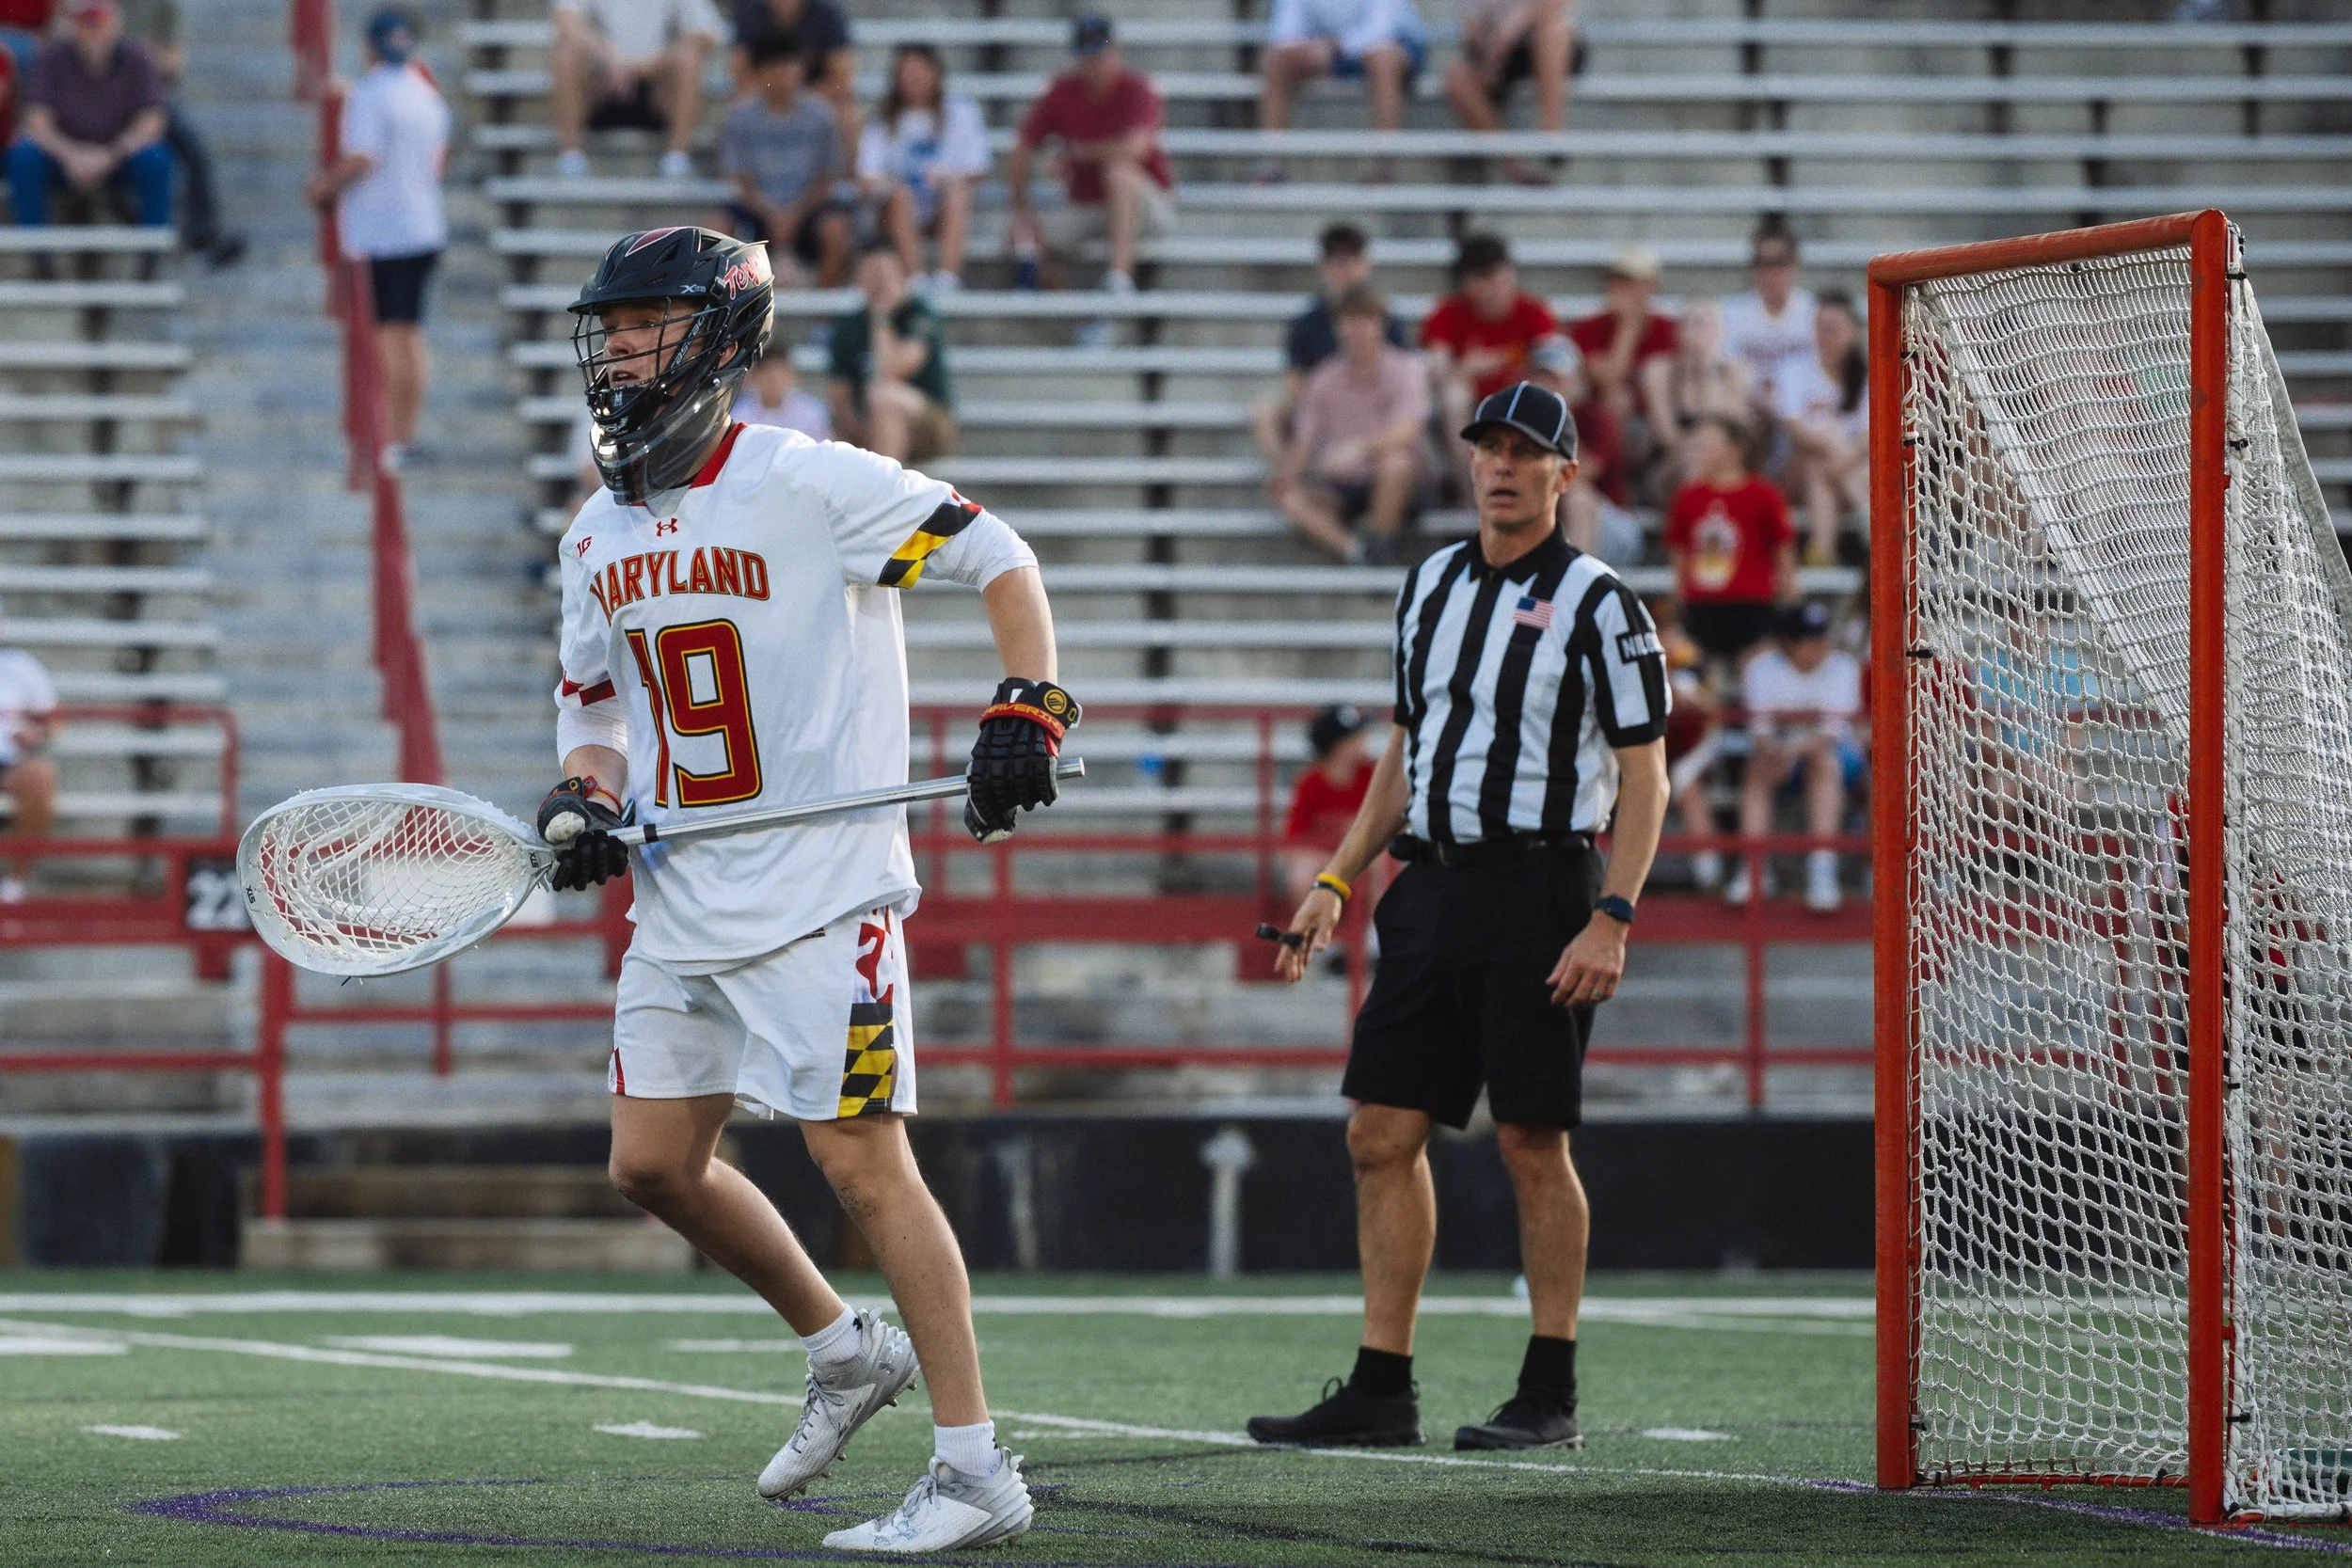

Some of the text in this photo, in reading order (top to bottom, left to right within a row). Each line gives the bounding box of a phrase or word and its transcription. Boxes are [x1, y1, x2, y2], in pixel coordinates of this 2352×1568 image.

[625, 618, 762, 808] 19
[529, 851, 539, 869] STX
[246, 885, 256, 904] STX
